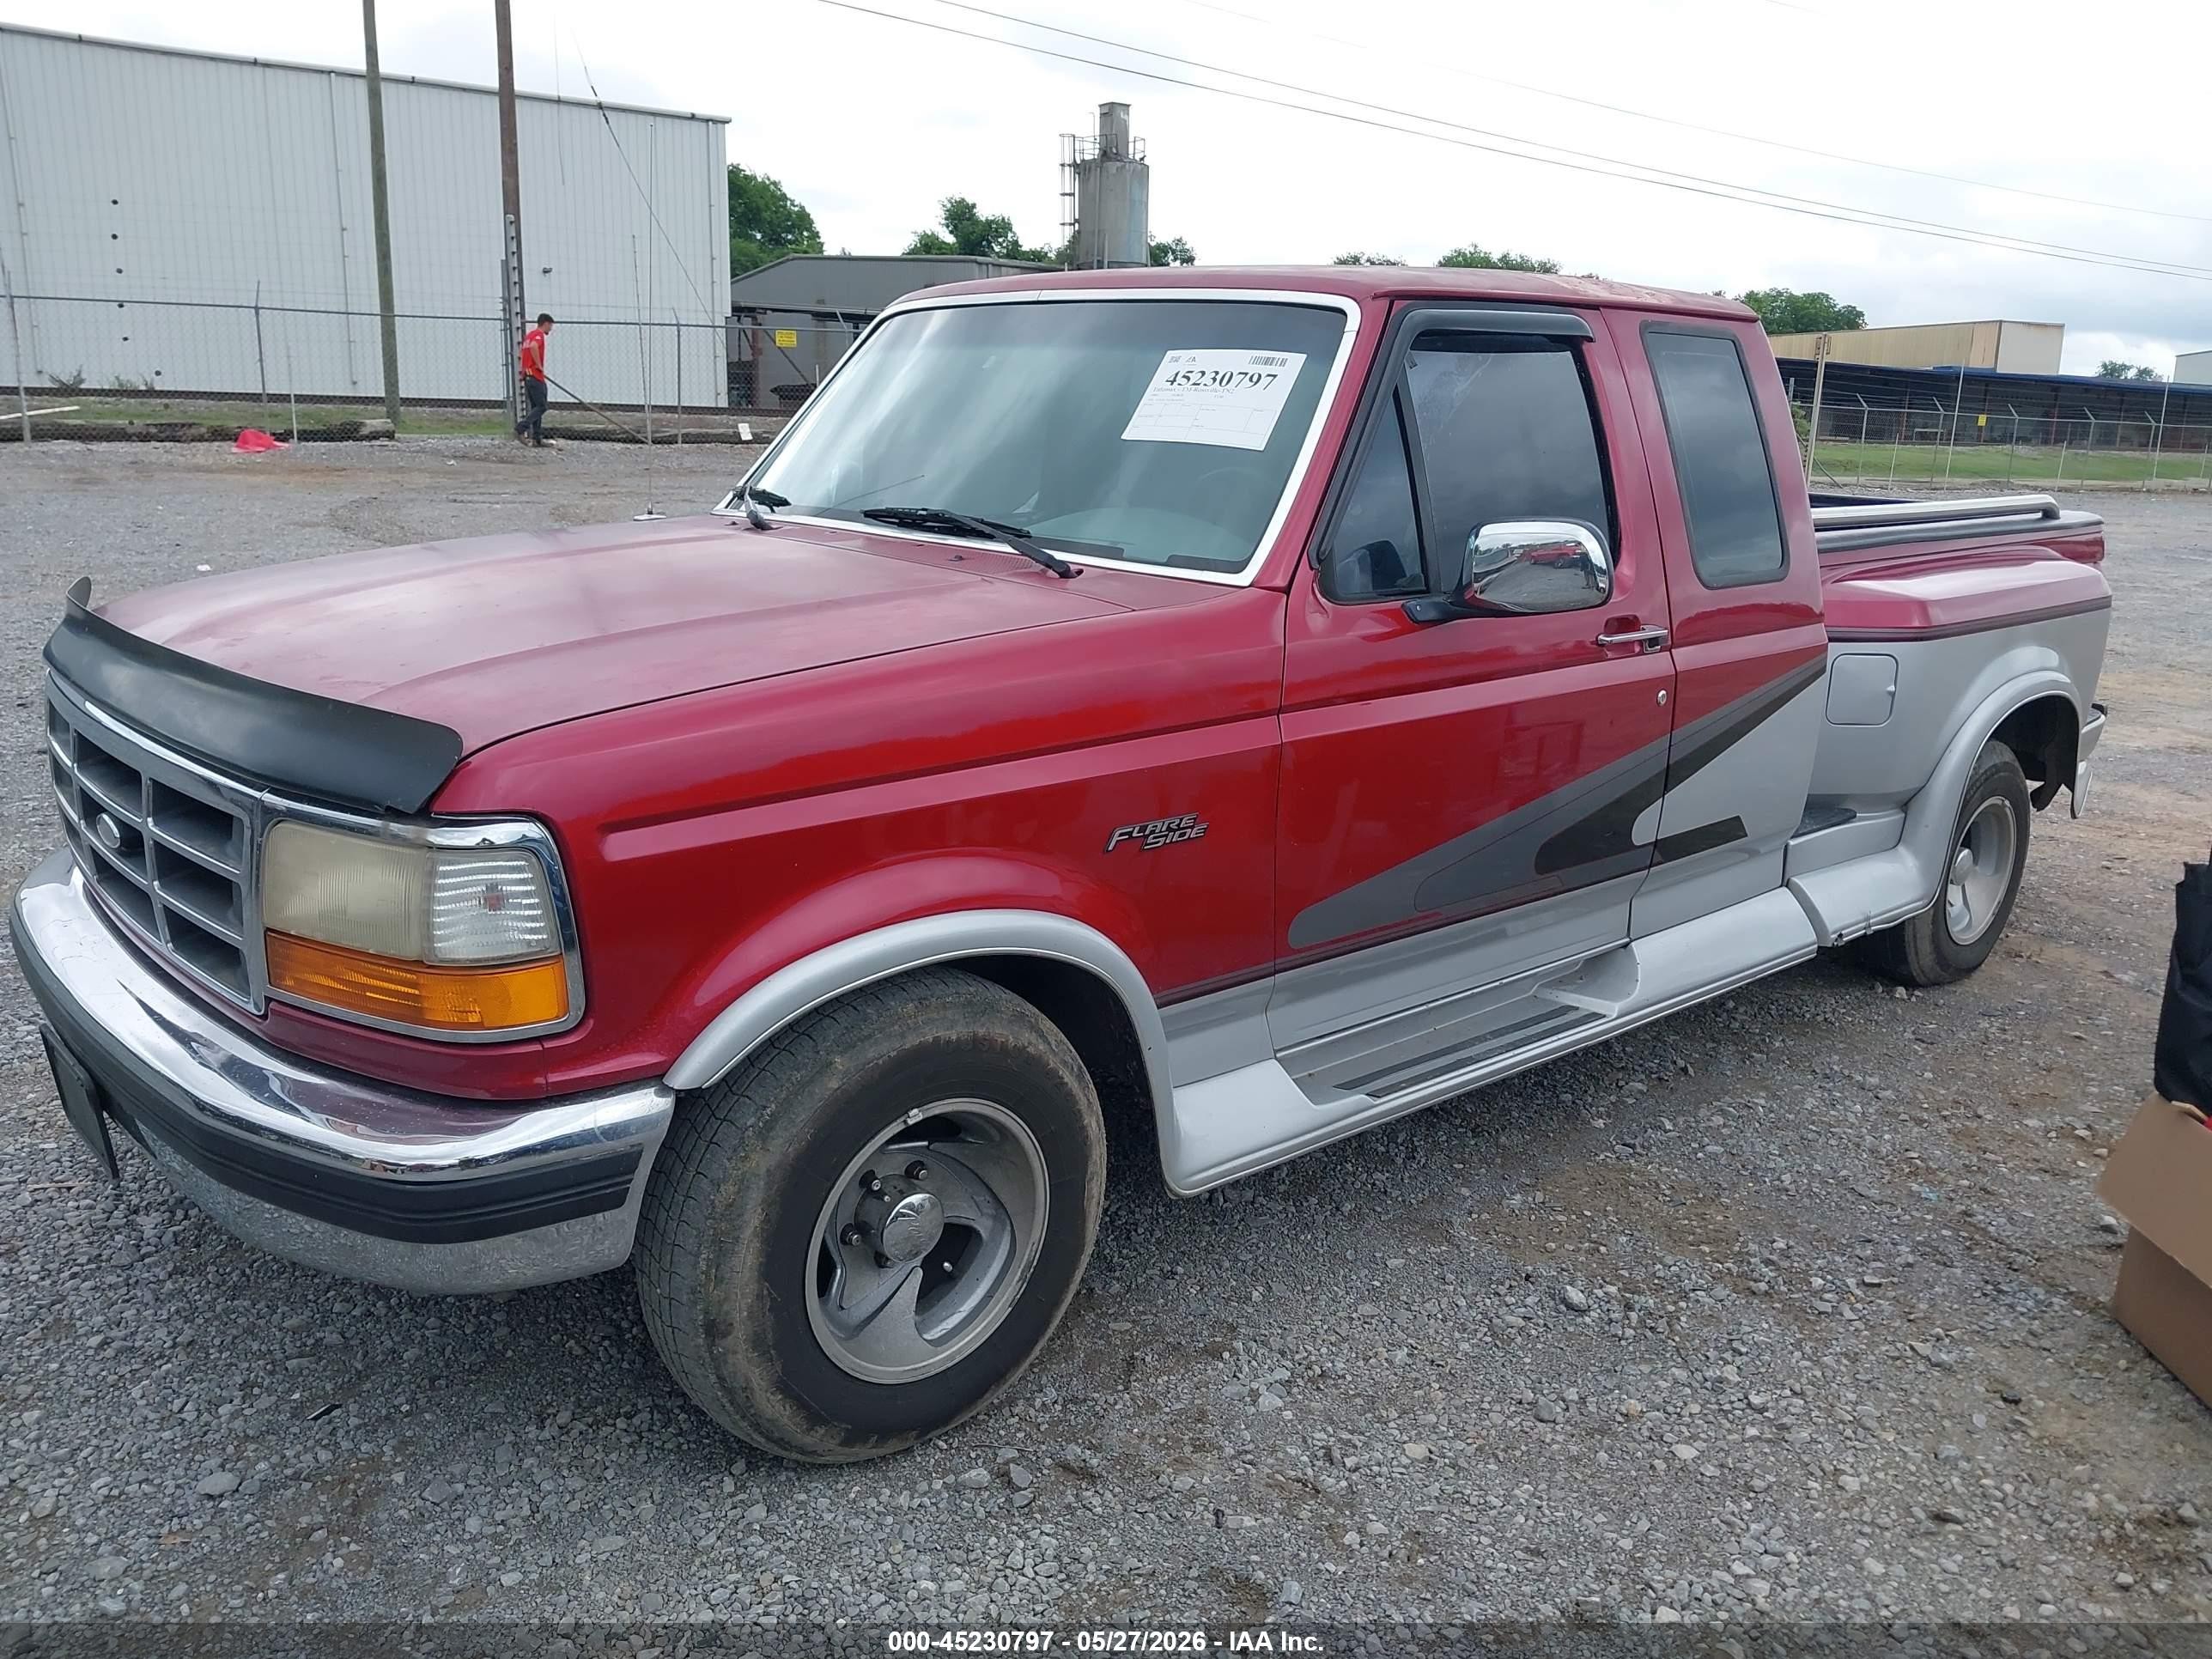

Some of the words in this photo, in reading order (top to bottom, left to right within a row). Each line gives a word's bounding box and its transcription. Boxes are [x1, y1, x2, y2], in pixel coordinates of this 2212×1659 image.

[1165, 370, 1279, 391] 45230797
[1107, 813, 1198, 852] FLARE
[1143, 823, 1208, 849] SIDE
